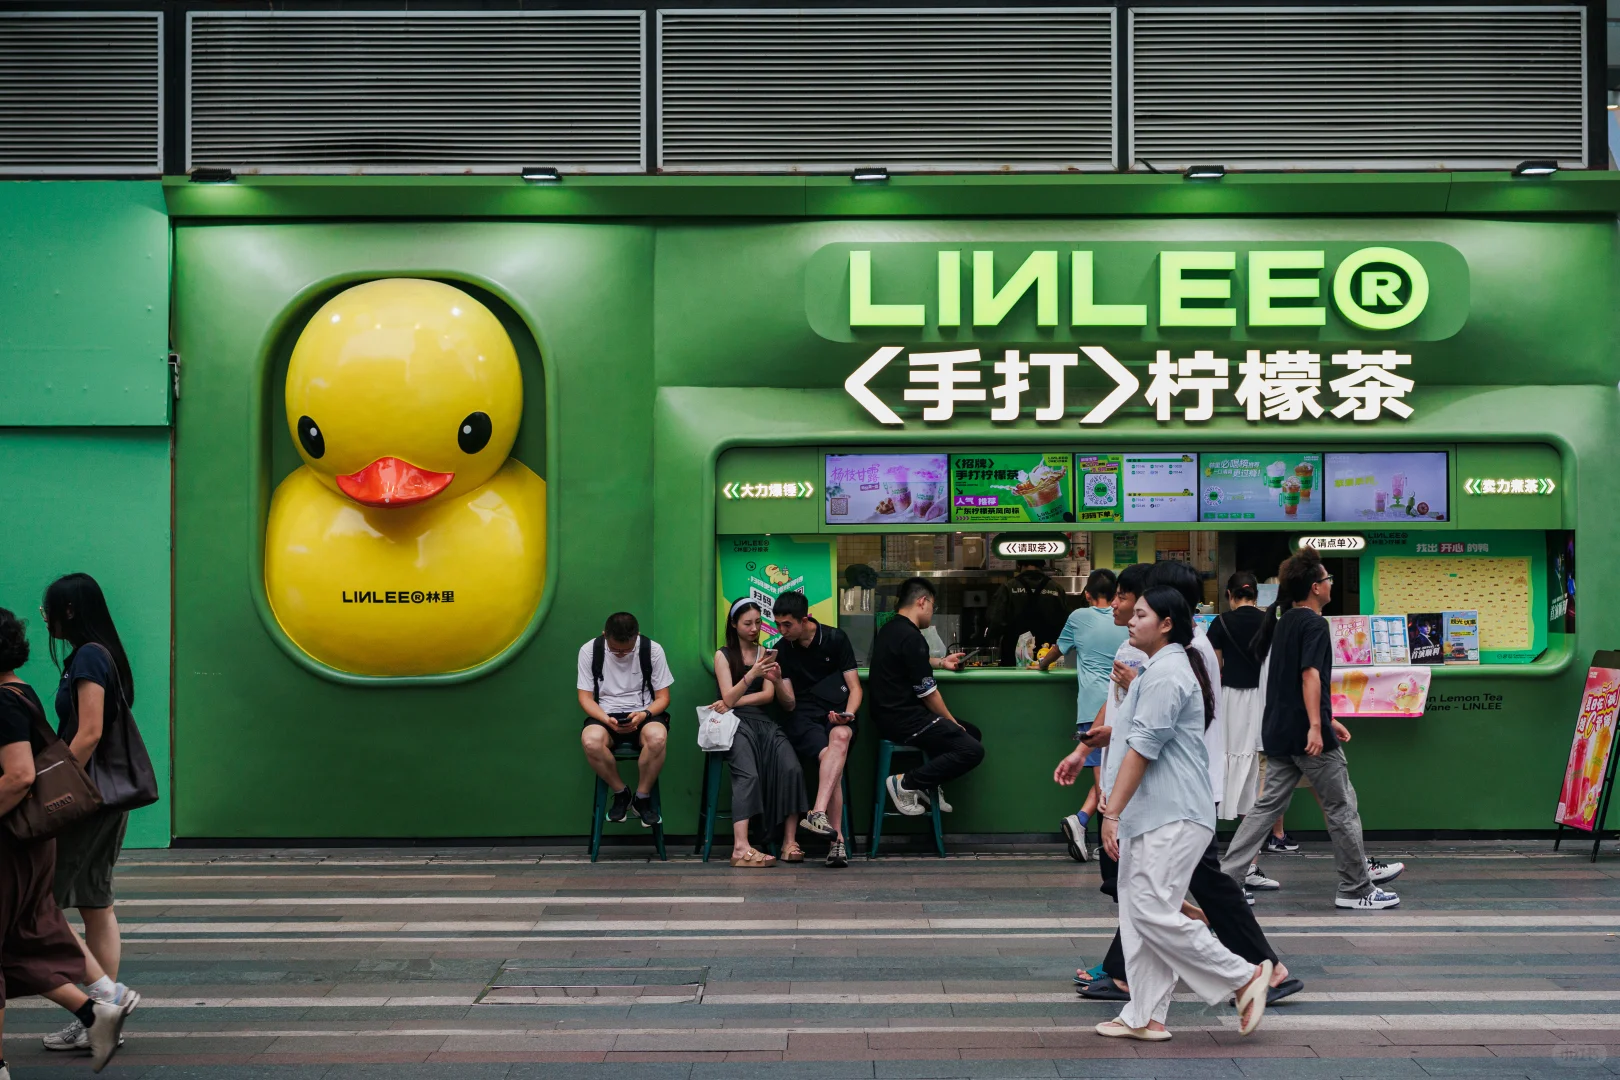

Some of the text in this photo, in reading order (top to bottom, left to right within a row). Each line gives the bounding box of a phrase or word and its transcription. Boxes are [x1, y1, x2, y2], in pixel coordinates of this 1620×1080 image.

[831, 464, 880, 483] 杨枝甘露
[956, 470, 1018, 480] 手打柠檬茶
[956, 497, 997, 505] 人气 推荐
[956, 507, 1020, 515] 广东柠檬茶风向标
[1081, 510, 1111, 519] 扫码下单
[1018, 543, 1046, 552] 请取茶
[1317, 538, 1346, 548] 请点单
[1416, 543, 1437, 552] 找出
[1440, 543, 1464, 553] 开心
[753, 590, 772, 607] 扫码
[1440, 694, 1480, 702] Lemon
[1483, 693, 1503, 702] Tea
[1462, 702, 1502, 710] LINLEE
